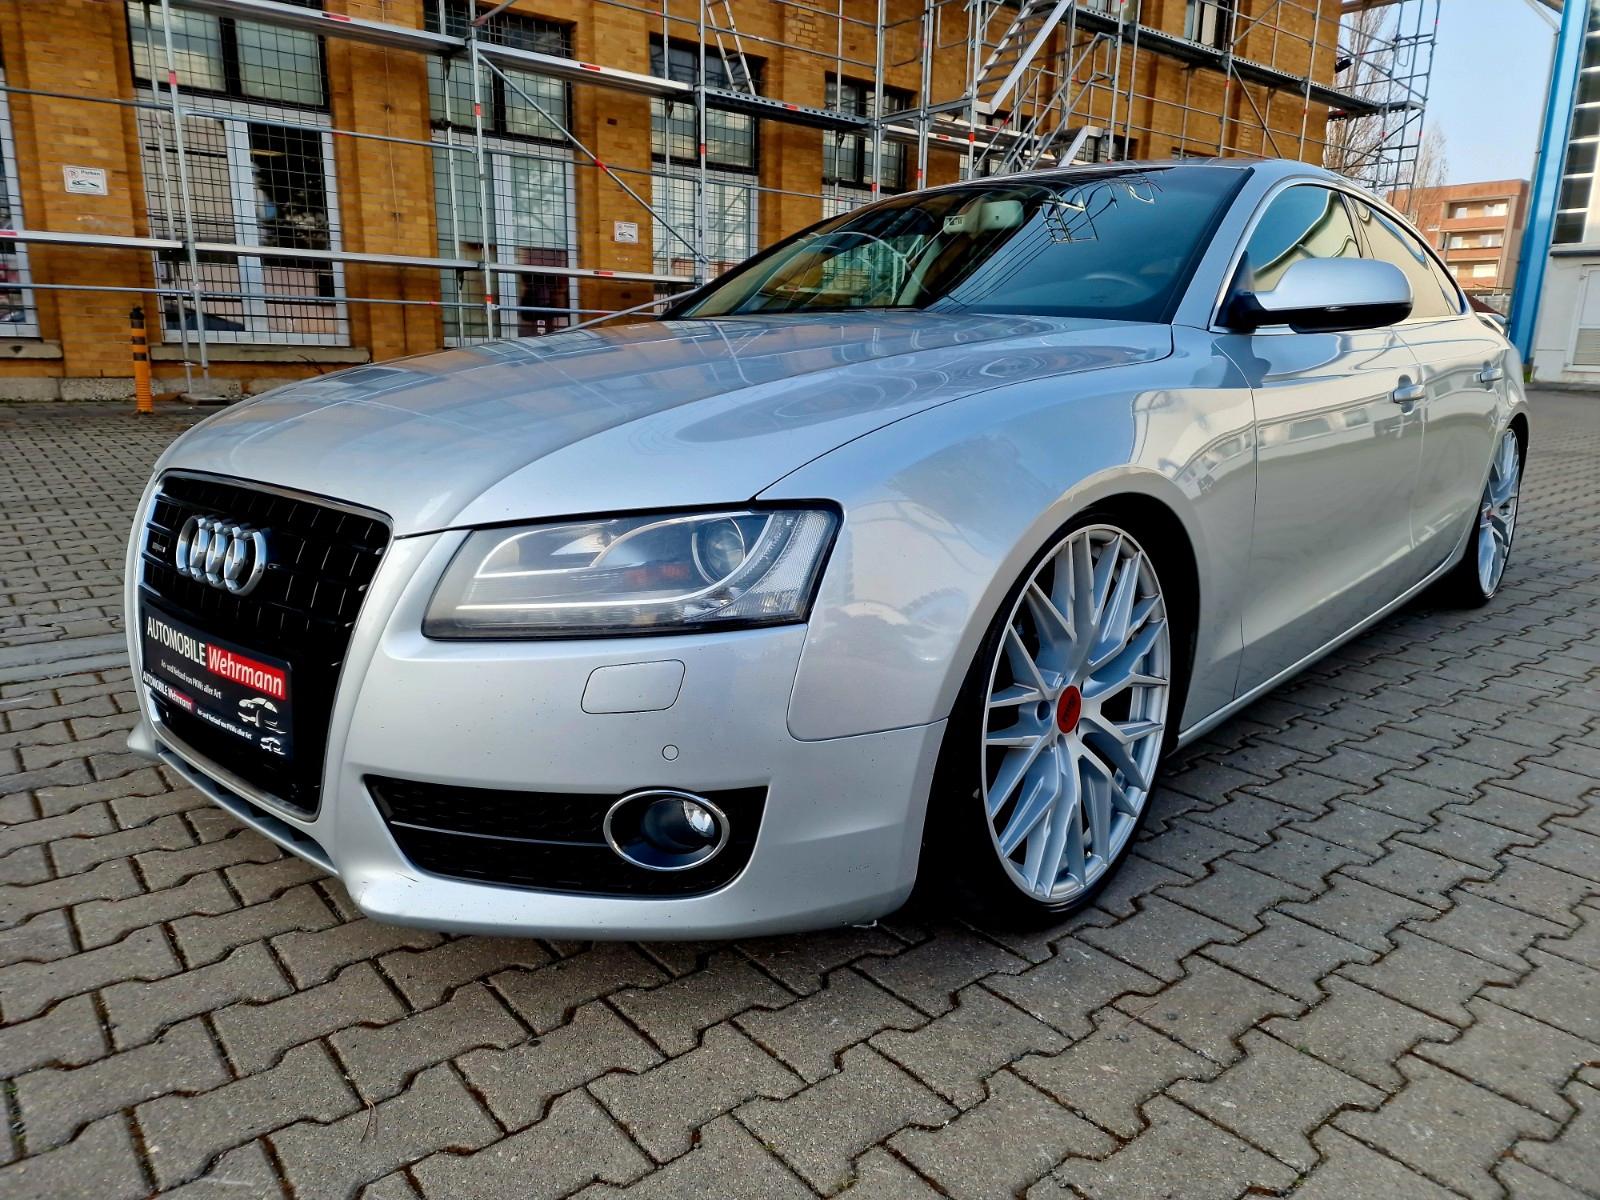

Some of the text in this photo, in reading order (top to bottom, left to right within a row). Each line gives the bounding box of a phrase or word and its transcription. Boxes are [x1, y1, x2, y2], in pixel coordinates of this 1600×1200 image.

[142, 670, 168, 697] AUTOMOBILE
[147, 616, 282, 697] AUTOMOBILE Wehrmann
